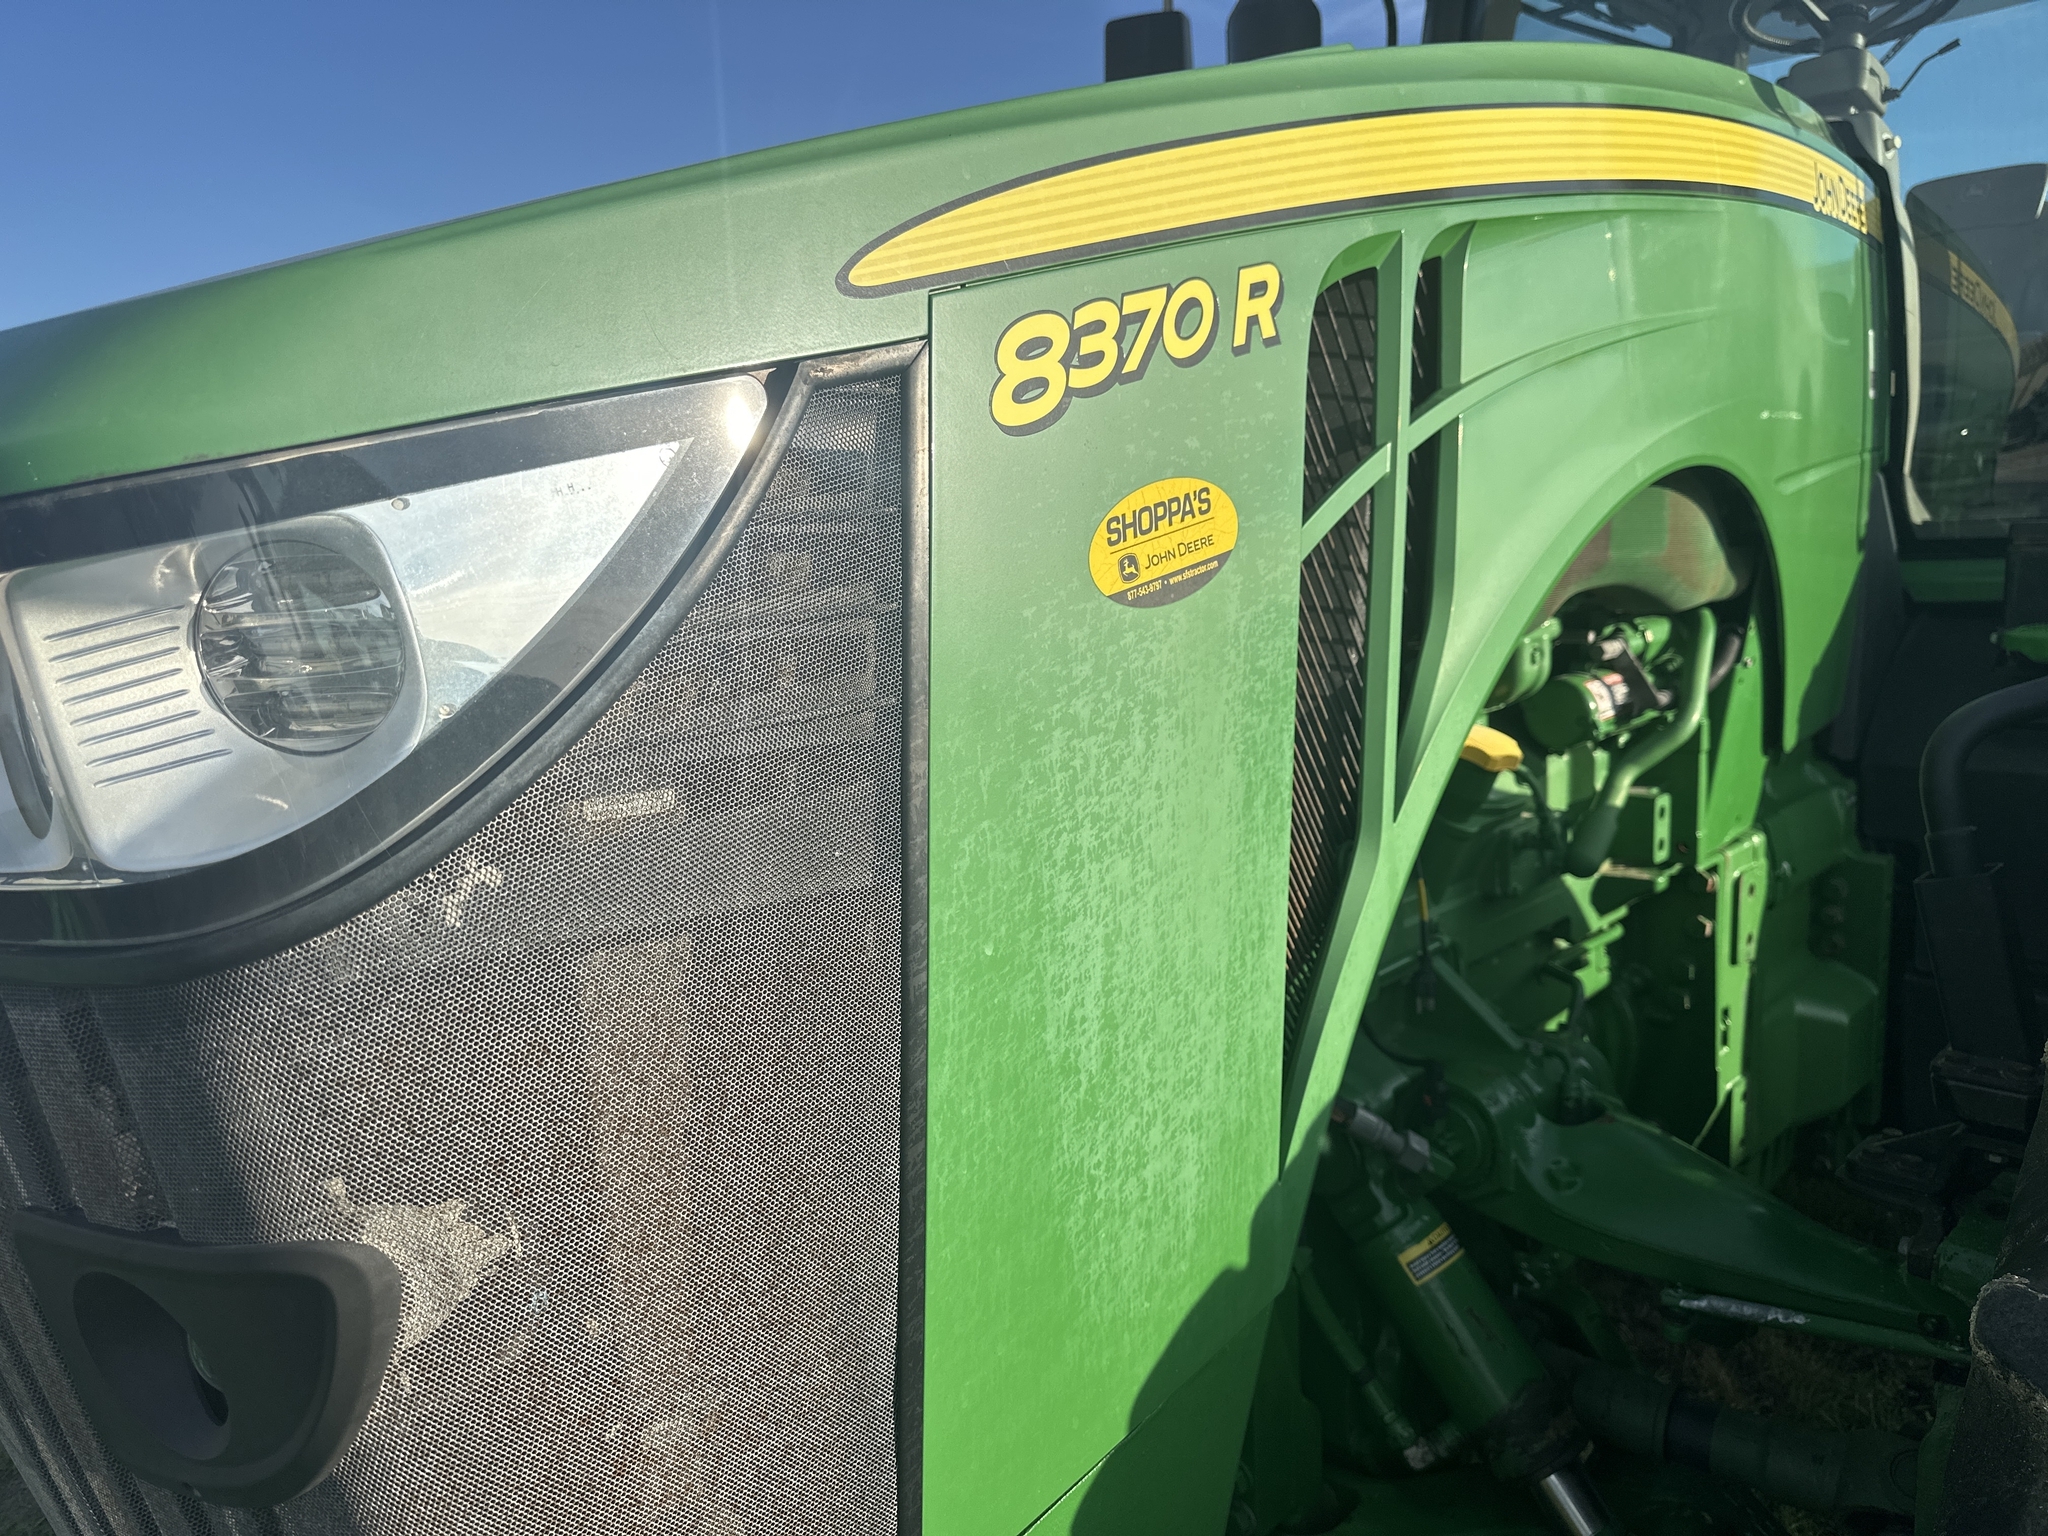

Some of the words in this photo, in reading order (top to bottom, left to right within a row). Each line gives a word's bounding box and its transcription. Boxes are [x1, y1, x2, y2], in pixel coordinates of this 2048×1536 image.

[1813, 161, 1838, 214] JOHN
[990, 276, 1219, 437] 8370
[1231, 261, 1284, 357] R
[1106, 487, 1211, 547] SHOPPA'S
[1145, 548, 1176, 569] JOHN
[1177, 534, 1215, 557] DEERE
[1126, 580, 1162, 601] 877-543-9797
[1168, 560, 1219, 585] www.sfstractor.com
